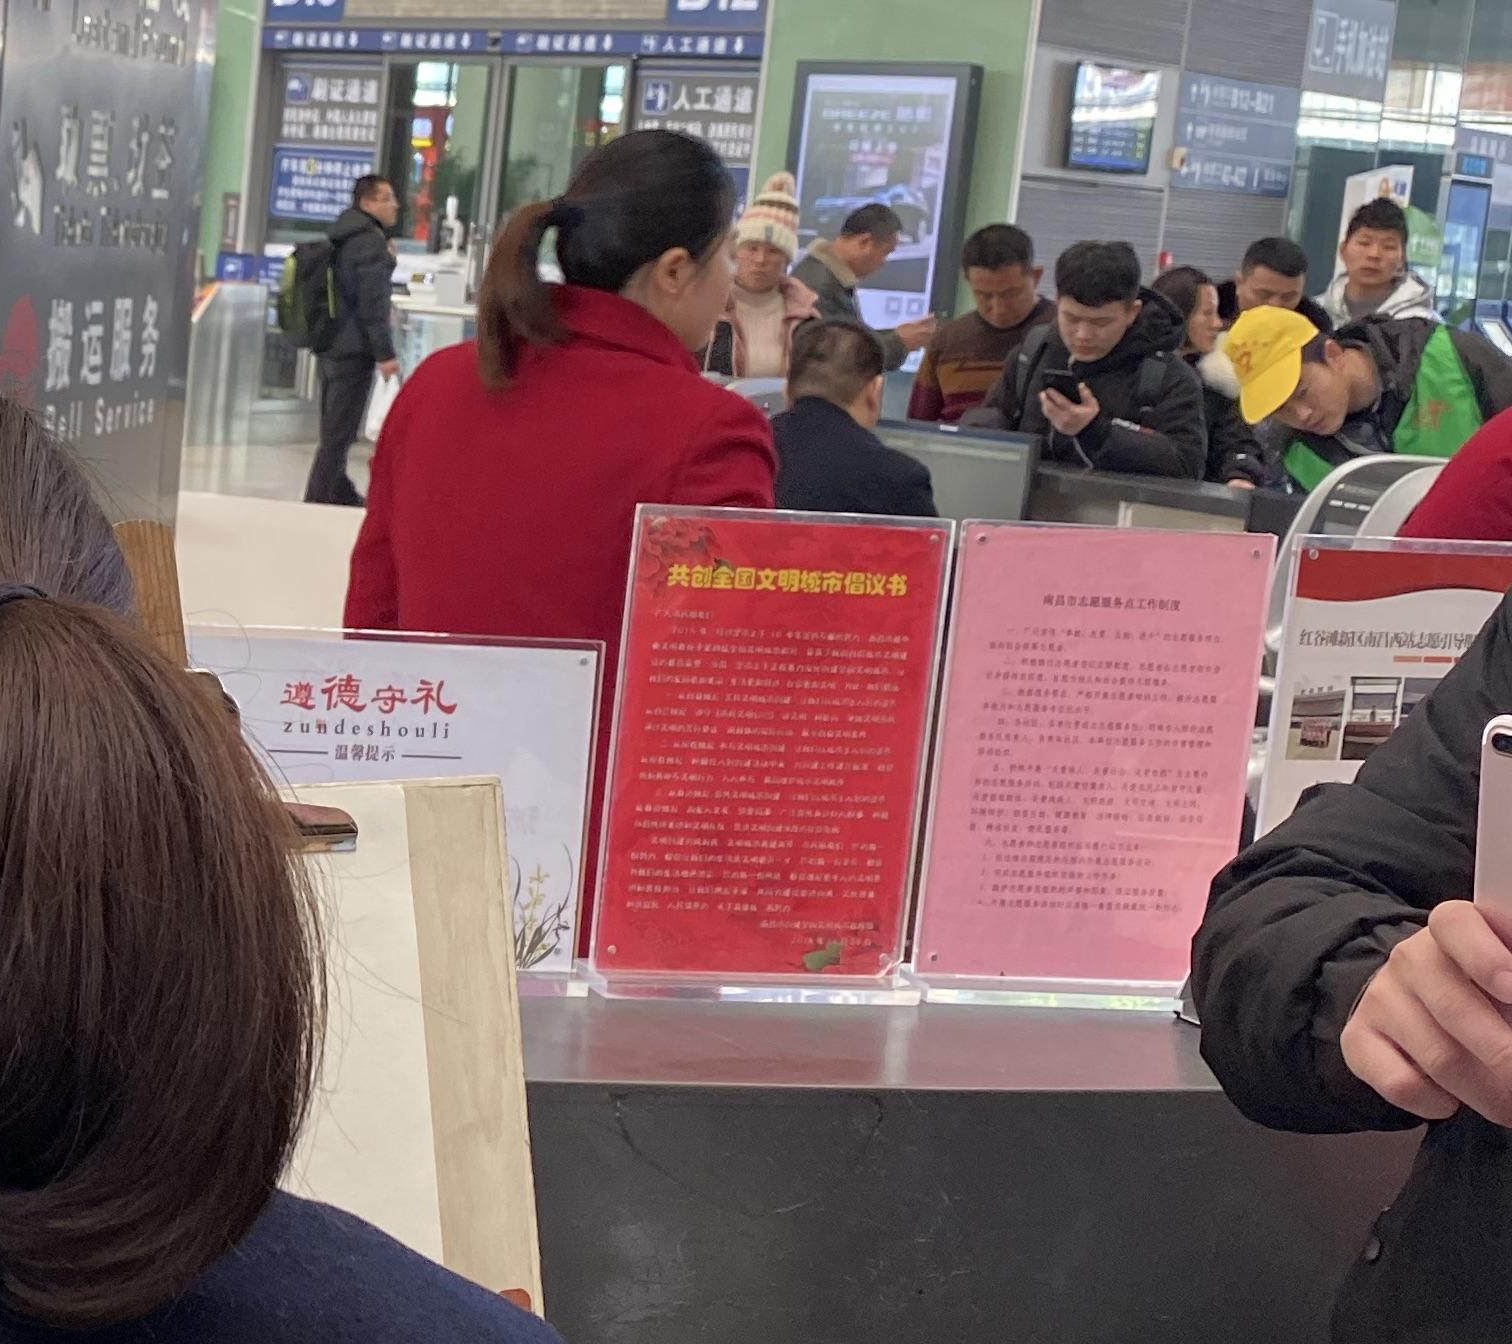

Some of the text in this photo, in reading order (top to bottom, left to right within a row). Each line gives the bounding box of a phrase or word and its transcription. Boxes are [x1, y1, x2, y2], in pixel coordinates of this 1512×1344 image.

[673, 84, 754, 114] 人工通道
[668, 564, 908, 597] 共创全国文明城市倡议书
[335, 744, 396, 762] 温馨提示
